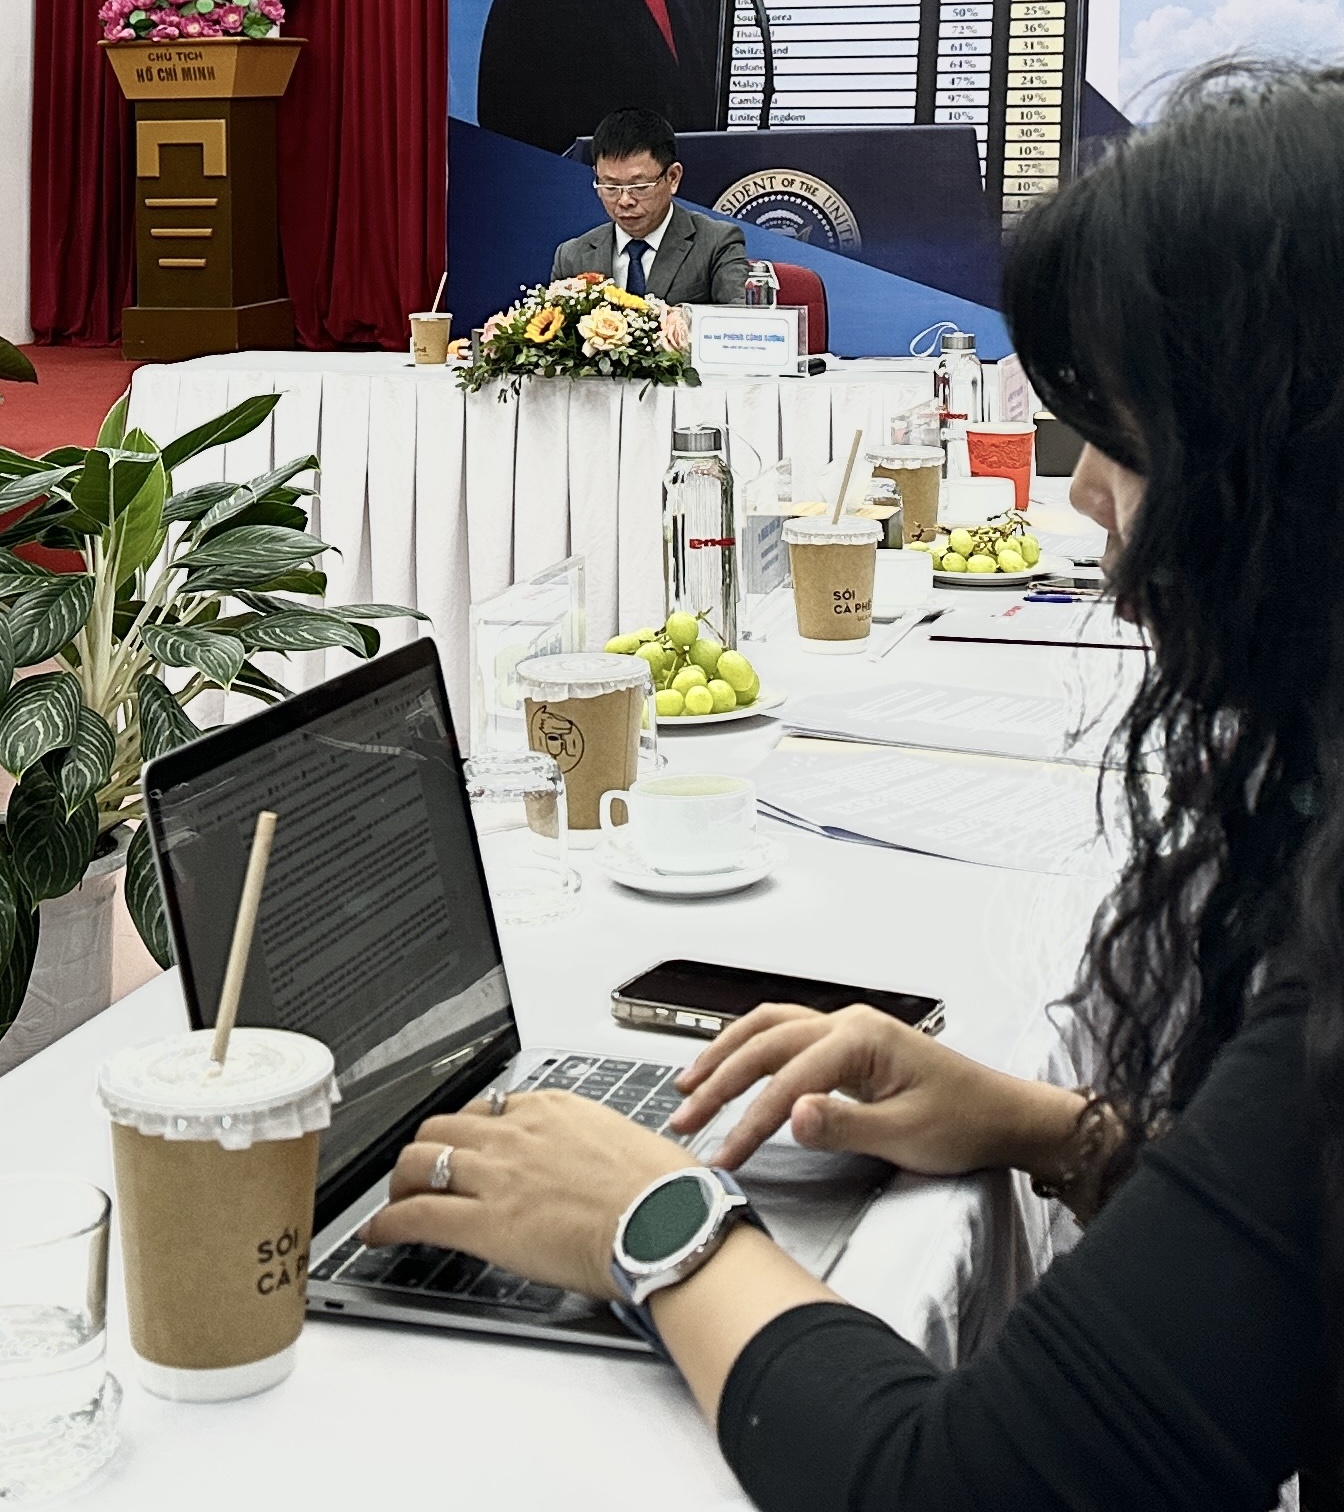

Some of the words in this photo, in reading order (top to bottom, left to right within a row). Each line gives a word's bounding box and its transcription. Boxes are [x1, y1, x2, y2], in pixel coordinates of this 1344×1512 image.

[1023, 6, 1050, 16] 25%
[1023, 23, 1049, 33] 36%
[147, 48, 173, 62] CHỦ
[176, 51, 204, 64] TỊCH
[136, 65, 154, 83] HỒ
[157, 63, 178, 82] CHÍ
[181, 65, 216, 82] MINH
[1020, 93, 1046, 102] 49%
[770, 113, 806, 123] ingdom
[948, 111, 974, 121] 10%
[1020, 110, 1046, 120] 10%
[1018, 128, 1045, 138] 30%
[1019, 145, 1045, 156] 10%
[1017, 163, 1044, 174] 37%
[1017, 181, 1044, 192] 10%
[720, 176, 777, 216] SIDENT
[781, 178, 796, 188] OF
[799, 180, 819, 197] THE
[822, 194, 855, 249] UNITE
[833, 588, 855, 601] SÓI
[833, 602, 852, 615] CÀ
[257, 1228, 298, 1263] SÓI
[257, 1261, 291, 1296] CÀ
